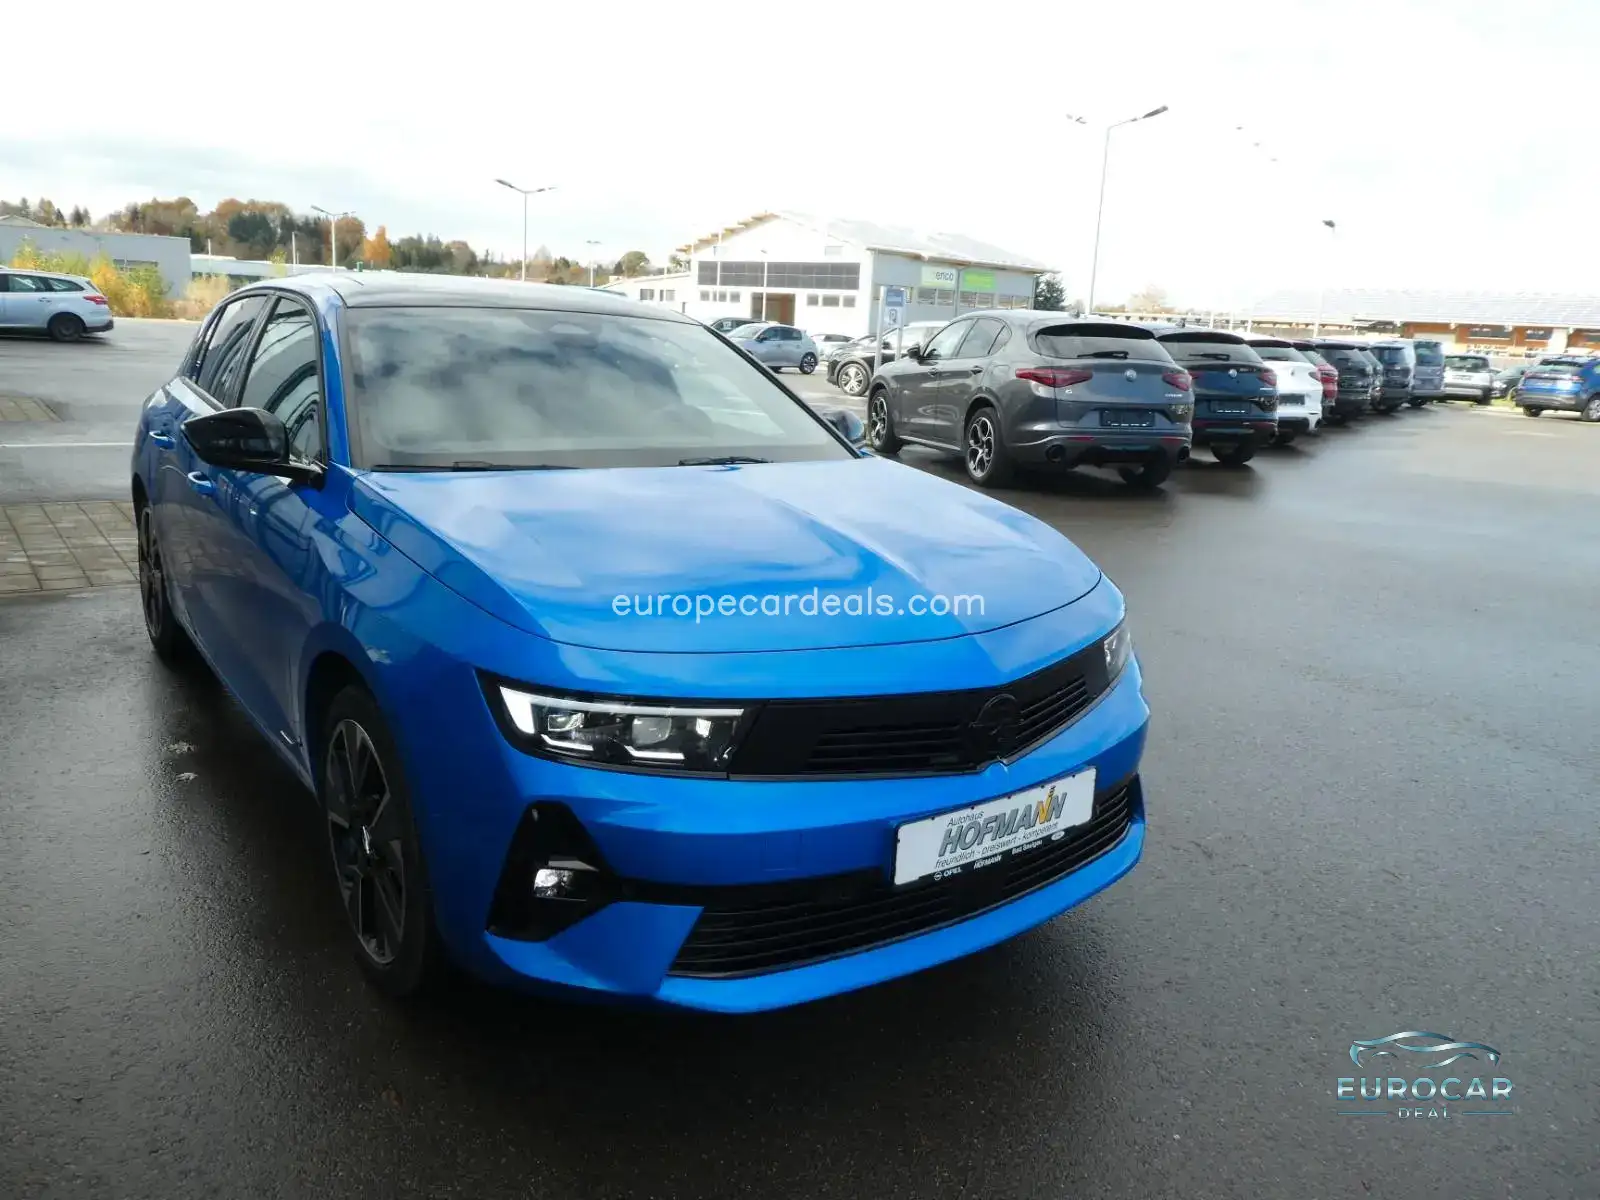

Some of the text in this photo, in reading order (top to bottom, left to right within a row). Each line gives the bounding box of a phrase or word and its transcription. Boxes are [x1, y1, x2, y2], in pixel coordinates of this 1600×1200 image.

[938, 787, 1068, 857] HOFMANN
[947, 810, 985, 826] Autohaus
[934, 849, 975, 869] freundlich
[981, 838, 1017, 857] preiswert
[943, 867, 962, 876] OPEL
